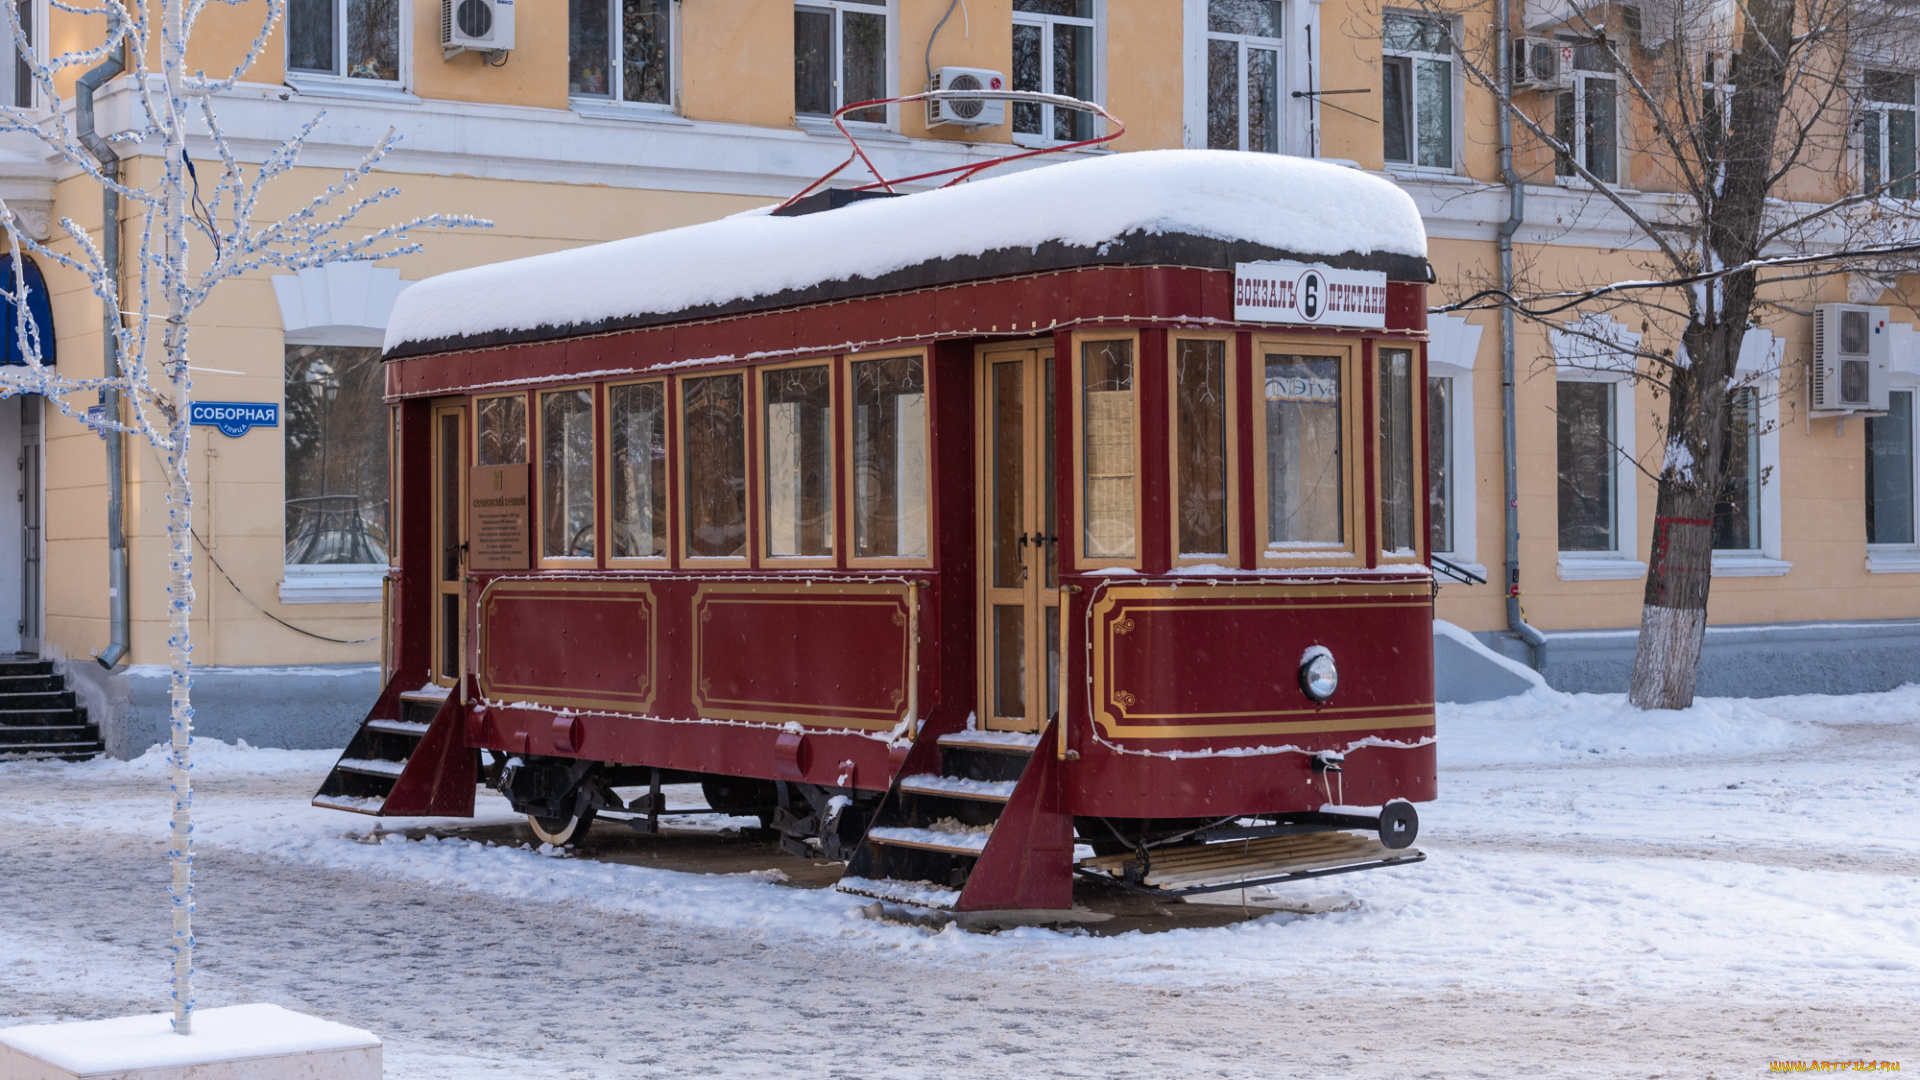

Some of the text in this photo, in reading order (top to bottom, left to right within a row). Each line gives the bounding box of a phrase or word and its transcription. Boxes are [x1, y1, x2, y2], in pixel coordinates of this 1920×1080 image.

[1236, 274, 1385, 318] ВОКЗАЛЪ 6 ПРИСТАНИ
[193, 407, 275, 421] СОБОРНАЯ
[223, 423, 247, 434] УЛИЦА
